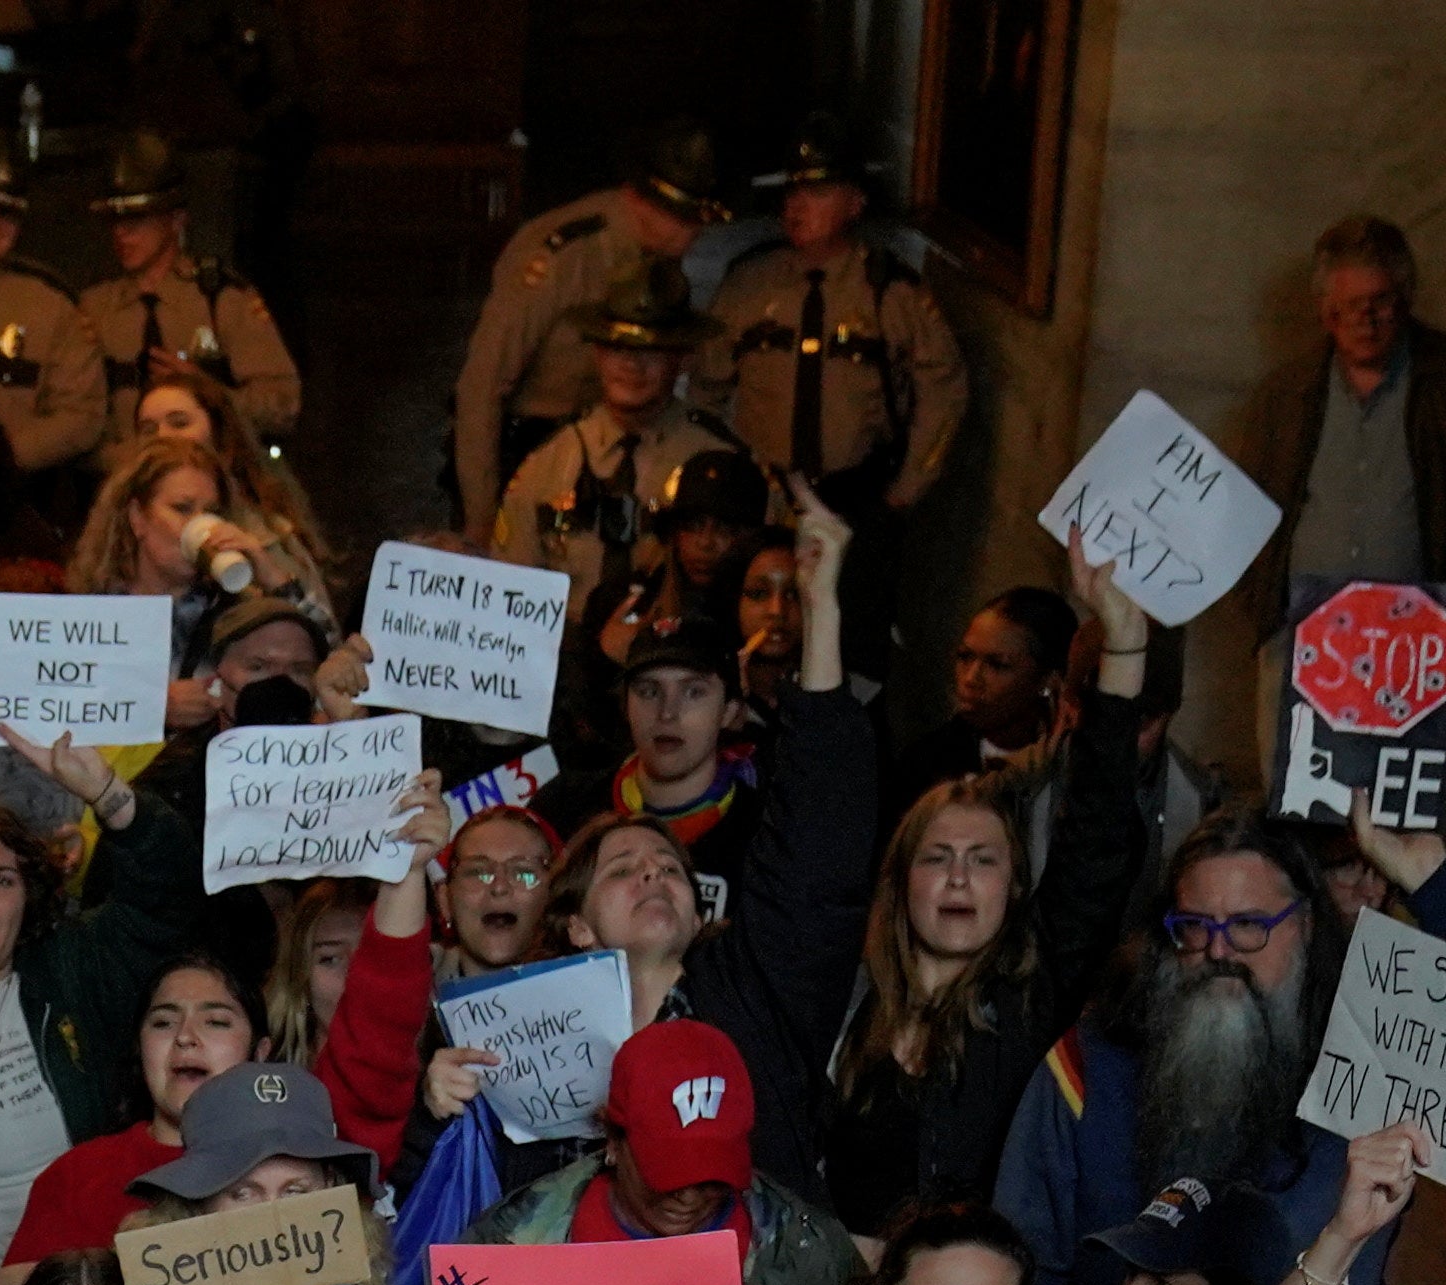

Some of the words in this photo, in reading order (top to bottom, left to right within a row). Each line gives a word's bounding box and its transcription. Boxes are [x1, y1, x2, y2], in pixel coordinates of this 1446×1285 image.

[1156, 434, 1221, 502] AM
[385, 561, 402, 591] I
[408, 568, 464, 601] TURN
[471, 580, 494, 612] 18
[503, 589, 565, 632] TODAY
[9, 619, 52, 643] WE
[62, 620, 129, 646] WILL
[36, 660, 98, 683] NOT
[384, 657, 461, 693] NEVER
[471, 670, 523, 701] WILL
[1314, 625, 1445, 701] STOP
[39, 698, 137, 724] SILENT
[361, 724, 406, 760] are
[226, 773, 277, 809] for
[292, 766, 409, 807] learning
[450, 769, 505, 821] TN
[505, 756, 538, 800] 3
[283, 803, 340, 835] NOT
[1362, 941, 1416, 996] WE
[1374, 1005, 1436, 1067] WITH
[483, 1053, 542, 1089] body
[1324, 1051, 1369, 1120] TN
[518, 1079, 592, 1129] JOKE
[672, 1075, 726, 1129] W
